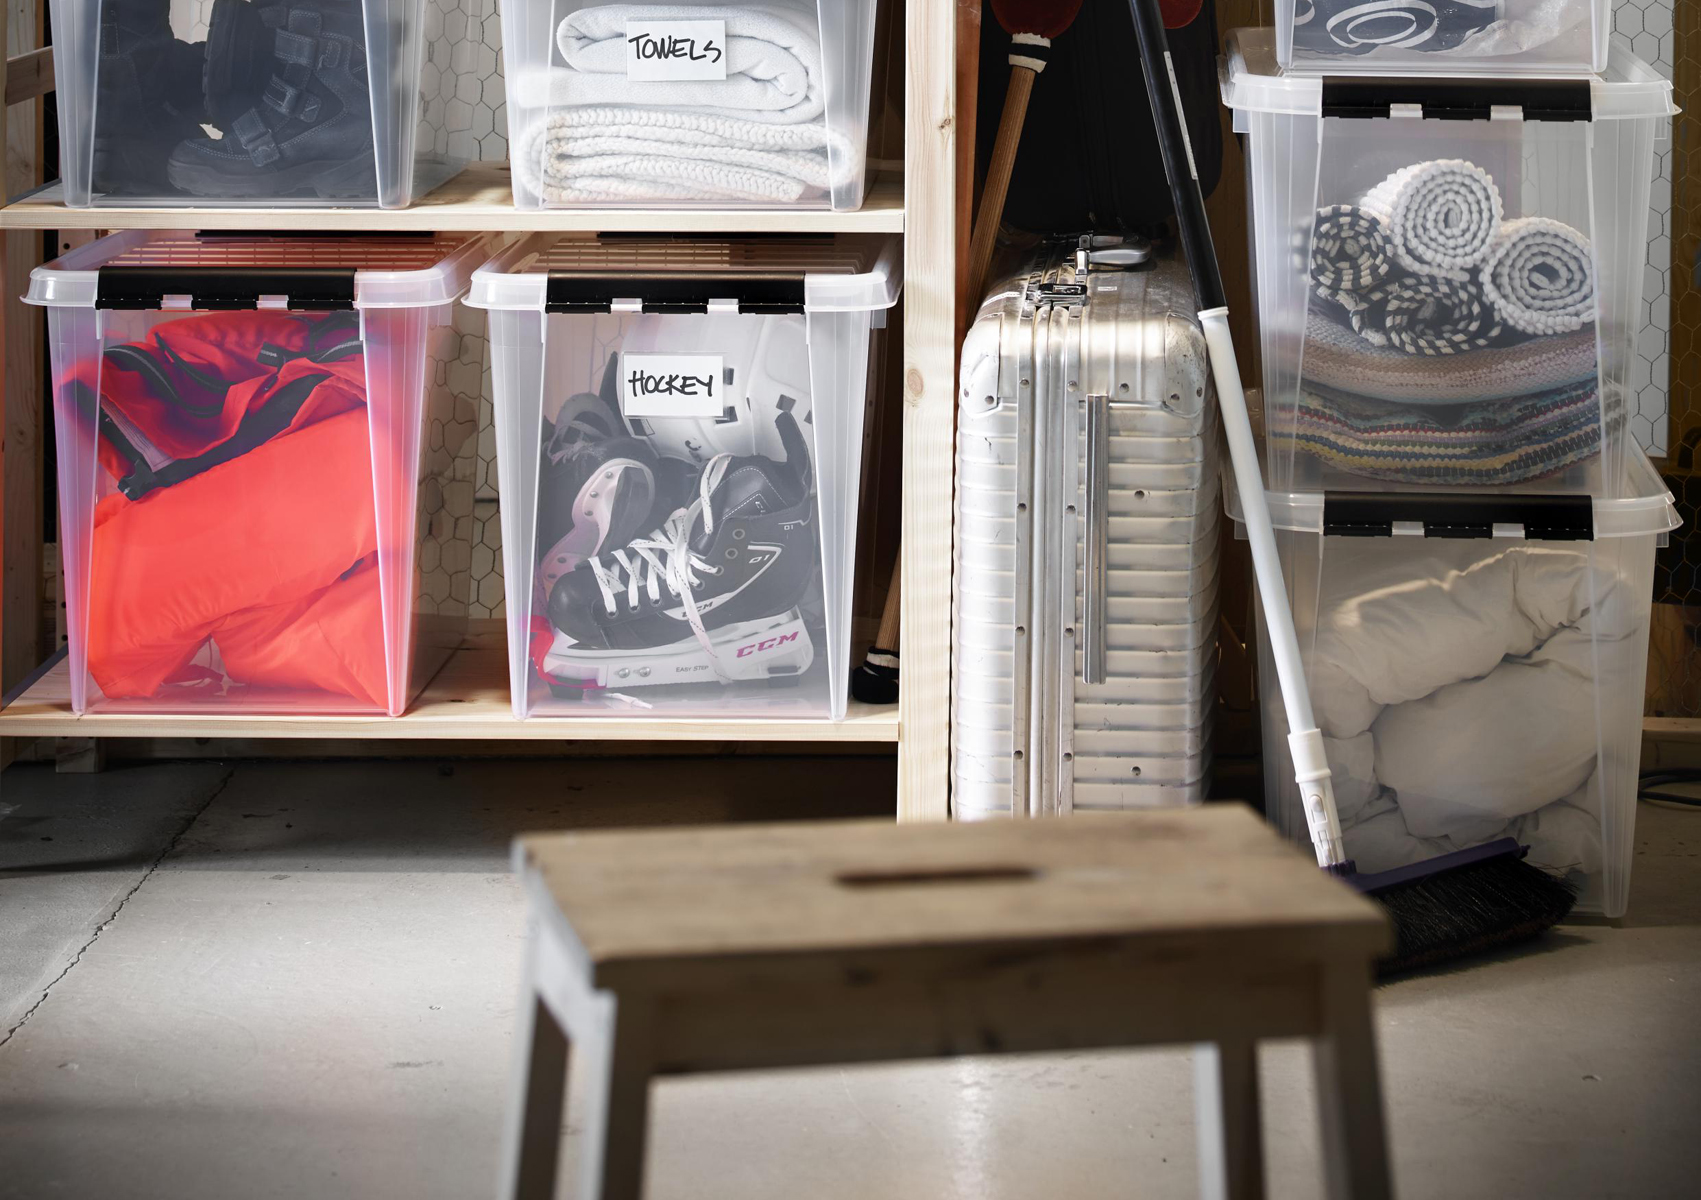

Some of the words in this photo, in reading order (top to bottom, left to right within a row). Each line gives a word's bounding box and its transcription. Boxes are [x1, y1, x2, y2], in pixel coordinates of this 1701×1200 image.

[628, 32, 722, 64] TOWELS
[627, 369, 713, 397] HOCKEY
[736, 630, 799, 658] CCM
